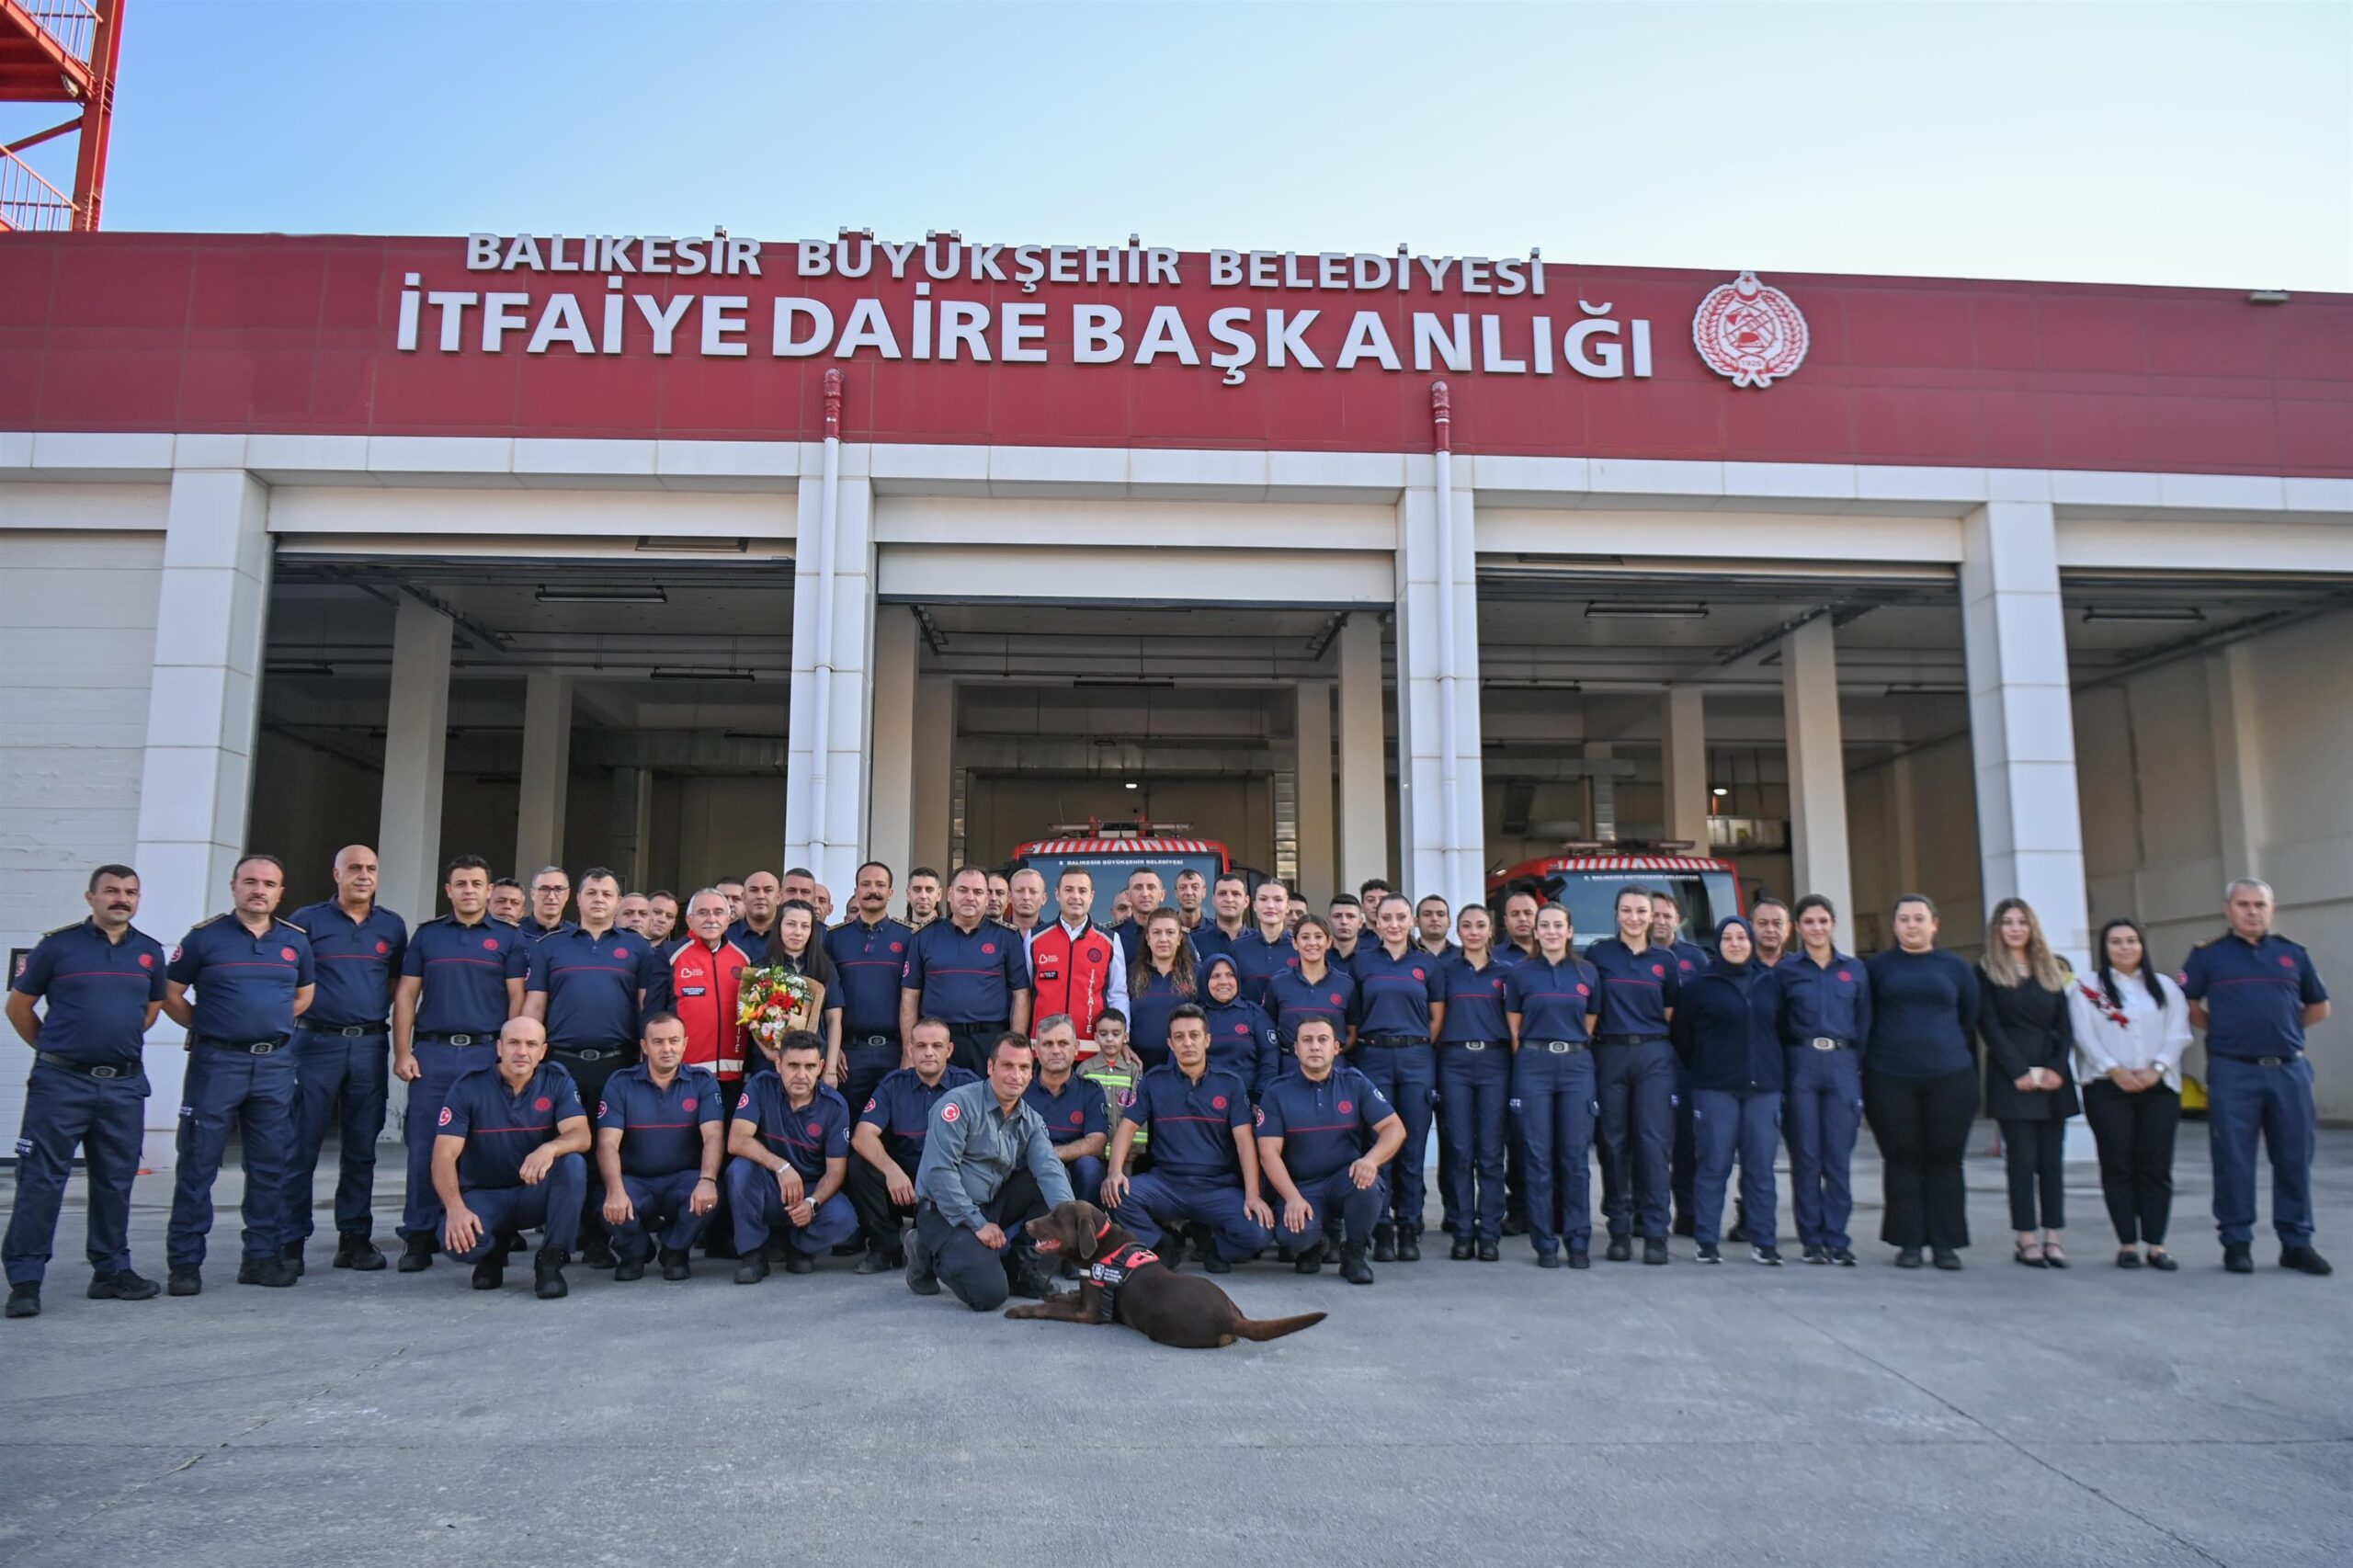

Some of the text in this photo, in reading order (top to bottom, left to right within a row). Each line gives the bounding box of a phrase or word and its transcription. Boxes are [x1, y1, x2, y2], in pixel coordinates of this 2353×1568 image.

[467, 224, 1545, 295] BALIKESİR BÜYÜKŞEHİR BELEDİYESİ
[396, 272, 1654, 385] İTFAİYE DAİRE BAŞKANLIĞI
